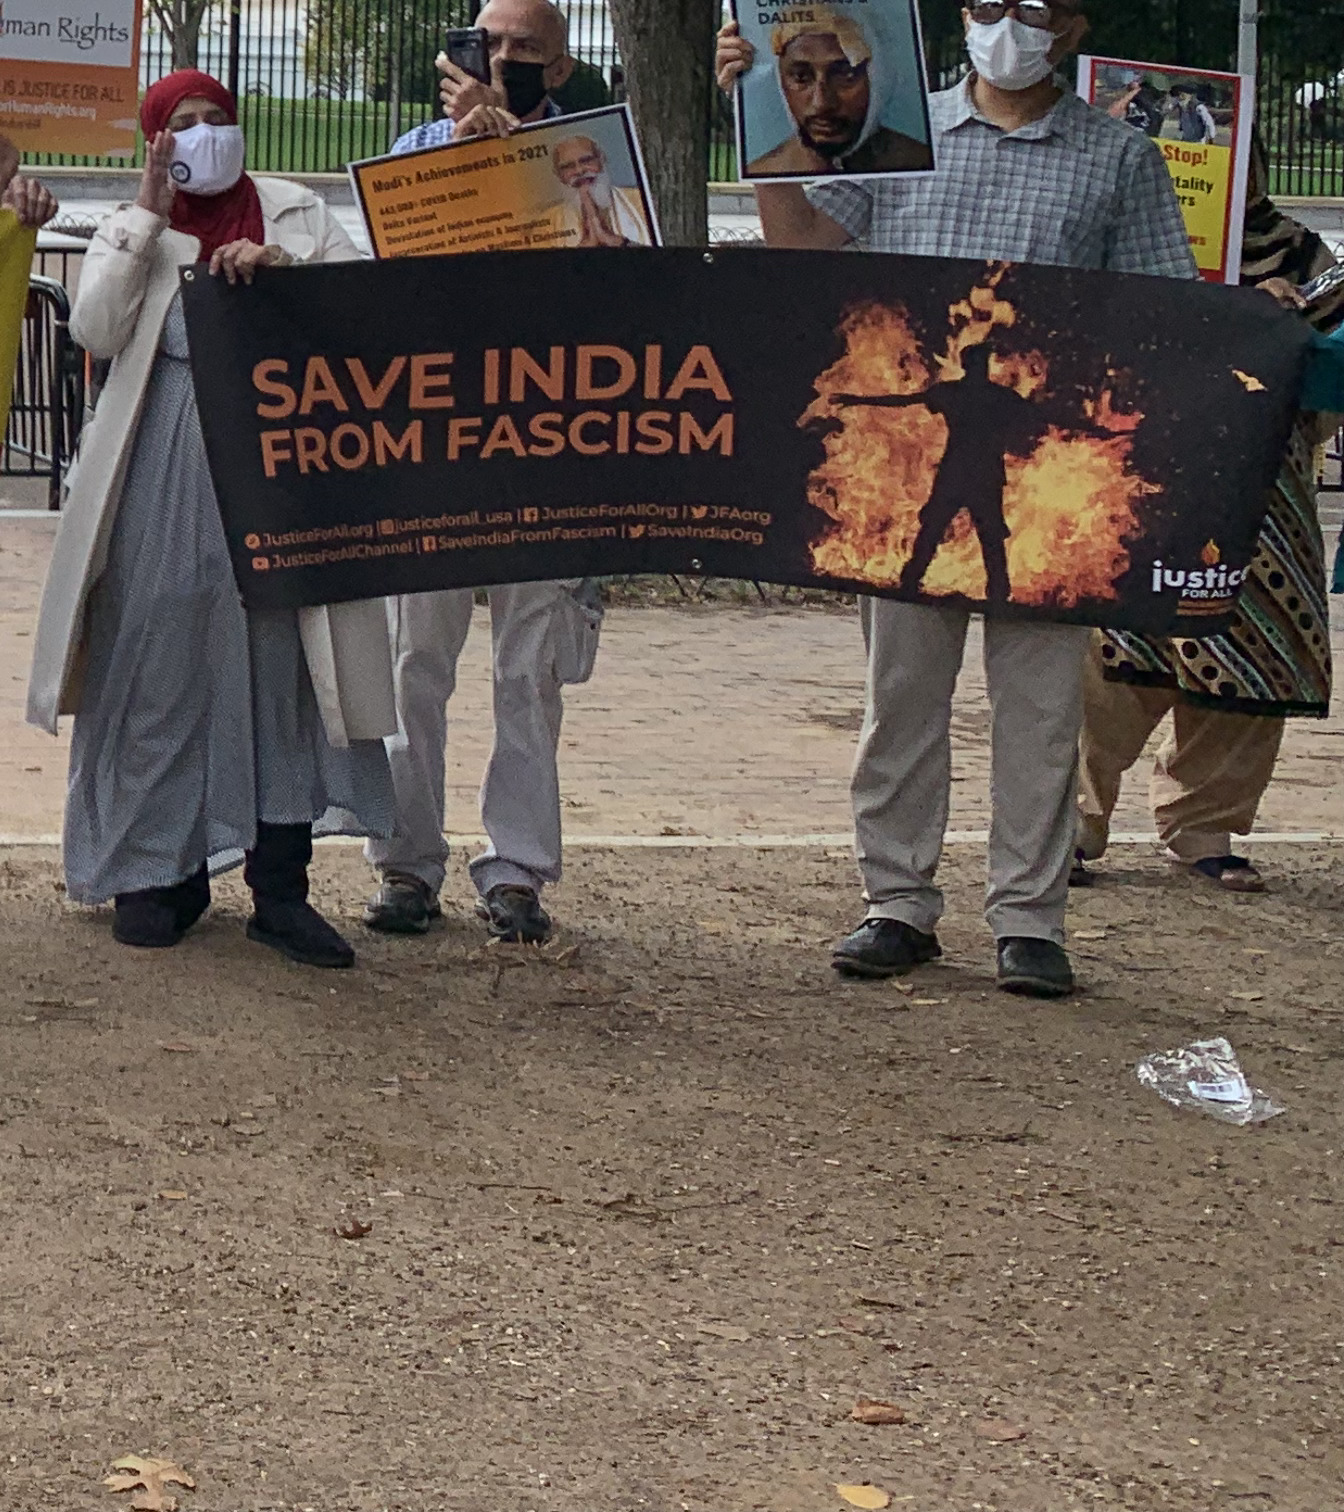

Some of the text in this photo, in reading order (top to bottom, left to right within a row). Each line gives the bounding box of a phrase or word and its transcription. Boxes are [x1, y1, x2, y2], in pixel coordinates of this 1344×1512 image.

[758, 10, 816, 25] DALITS
[58, 12, 129, 51] Rights
[3, 79, 15, 95] IS
[18, 81, 71, 99] JUSTICE
[72, 84, 98, 102] FOR
[100, 86, 125, 103] ALL
[1163, 144, 1208, 167] Stop!
[372, 144, 549, 194] Modi's Achievements in 2021
[421, 194, 448, 208] COVID
[449, 188, 479, 202] Deaths
[407, 212, 438, 226] Variant
[386, 228, 435, 245] Devastation
[437, 224, 445, 234] of
[532, 228, 577, 244] Christians
[252, 345, 733, 419] SAVE INDIA
[259, 410, 734, 478] FROM FASCISM
[541, 503, 677, 521] JusticeForAllOrg
[710, 505, 771, 525] JFAorg
[273, 524, 764, 568] JusticeForAllChannel SaveIndiaFromFascism SaveIndiaOrg
[1152, 560, 1247, 592] justic
[1182, 589, 1233, 599] FOR ALL
